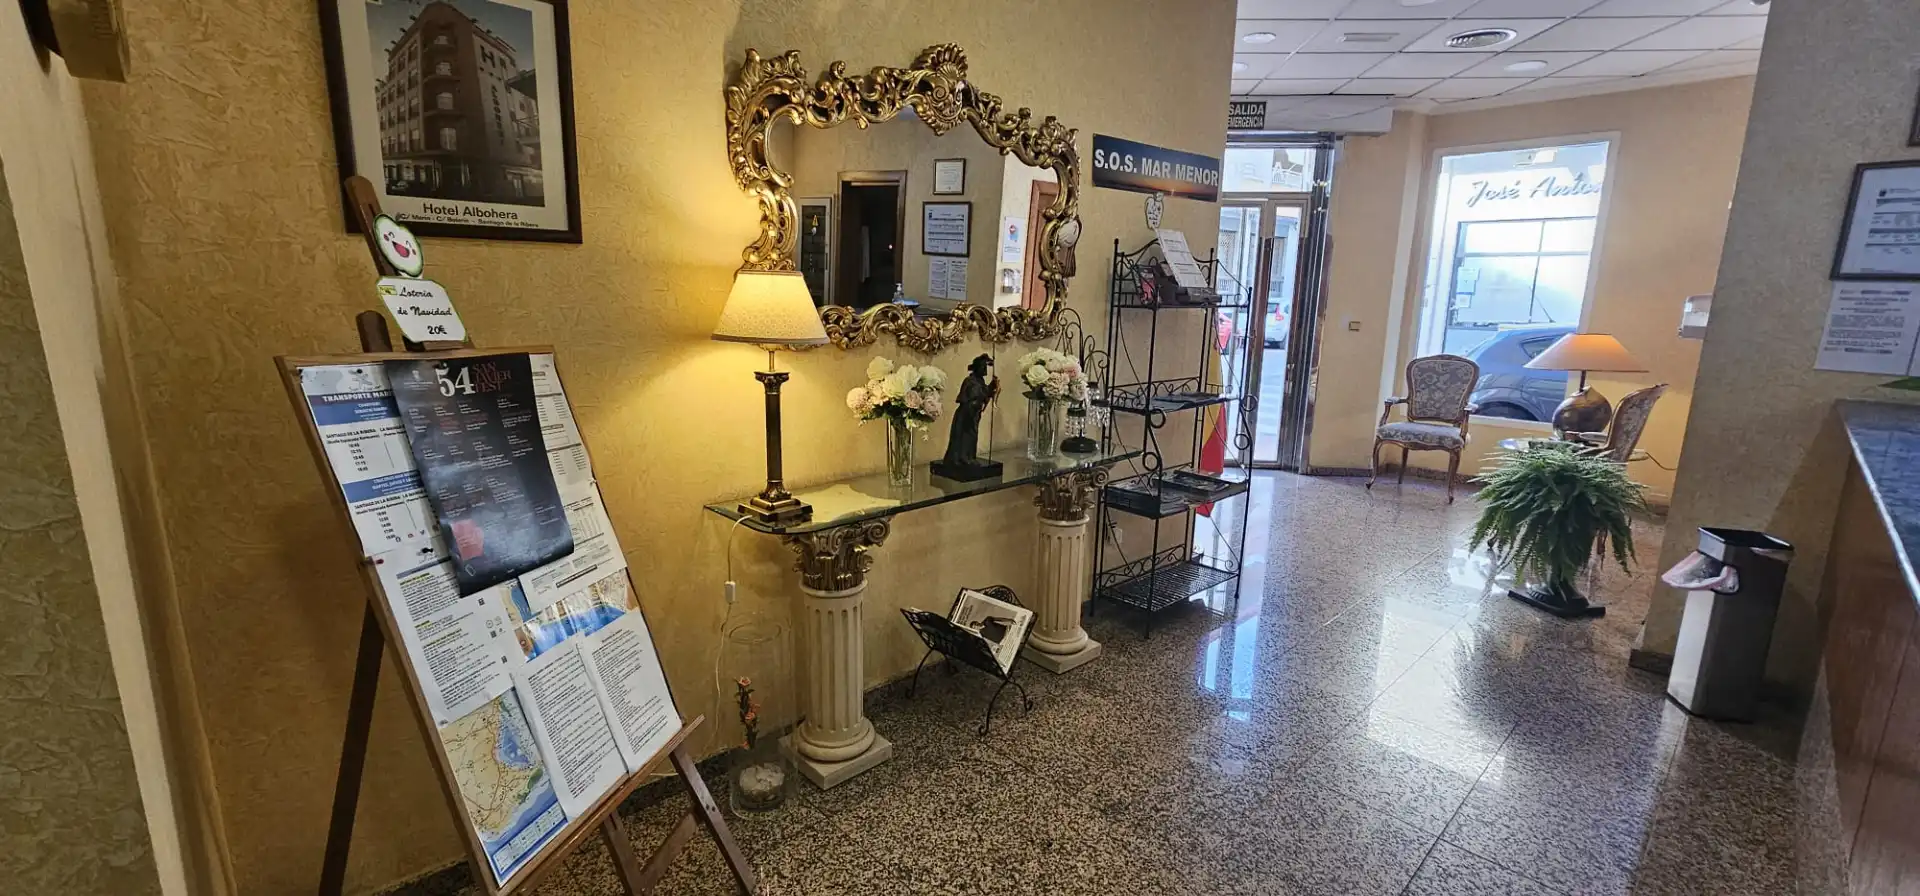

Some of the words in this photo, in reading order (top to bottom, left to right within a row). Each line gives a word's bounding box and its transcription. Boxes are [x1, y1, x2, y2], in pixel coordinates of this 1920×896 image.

[1228, 103, 1265, 116] SALIDA
[1094, 148, 1137, 173] S.O.S.
[1141, 157, 1171, 179] MAR
[1175, 163, 1219, 187] MENOR
[1466, 179, 1522, 208] José
[422, 203, 459, 216] Hotel
[463, 206, 519, 220] Albohera
[397, 307, 408, 316] de
[410, 305, 453, 316] Navidad
[427, 325, 448, 336] 20€
[434, 366, 476, 397] 54
[321, 392, 372, 402] TRANSPORTE
